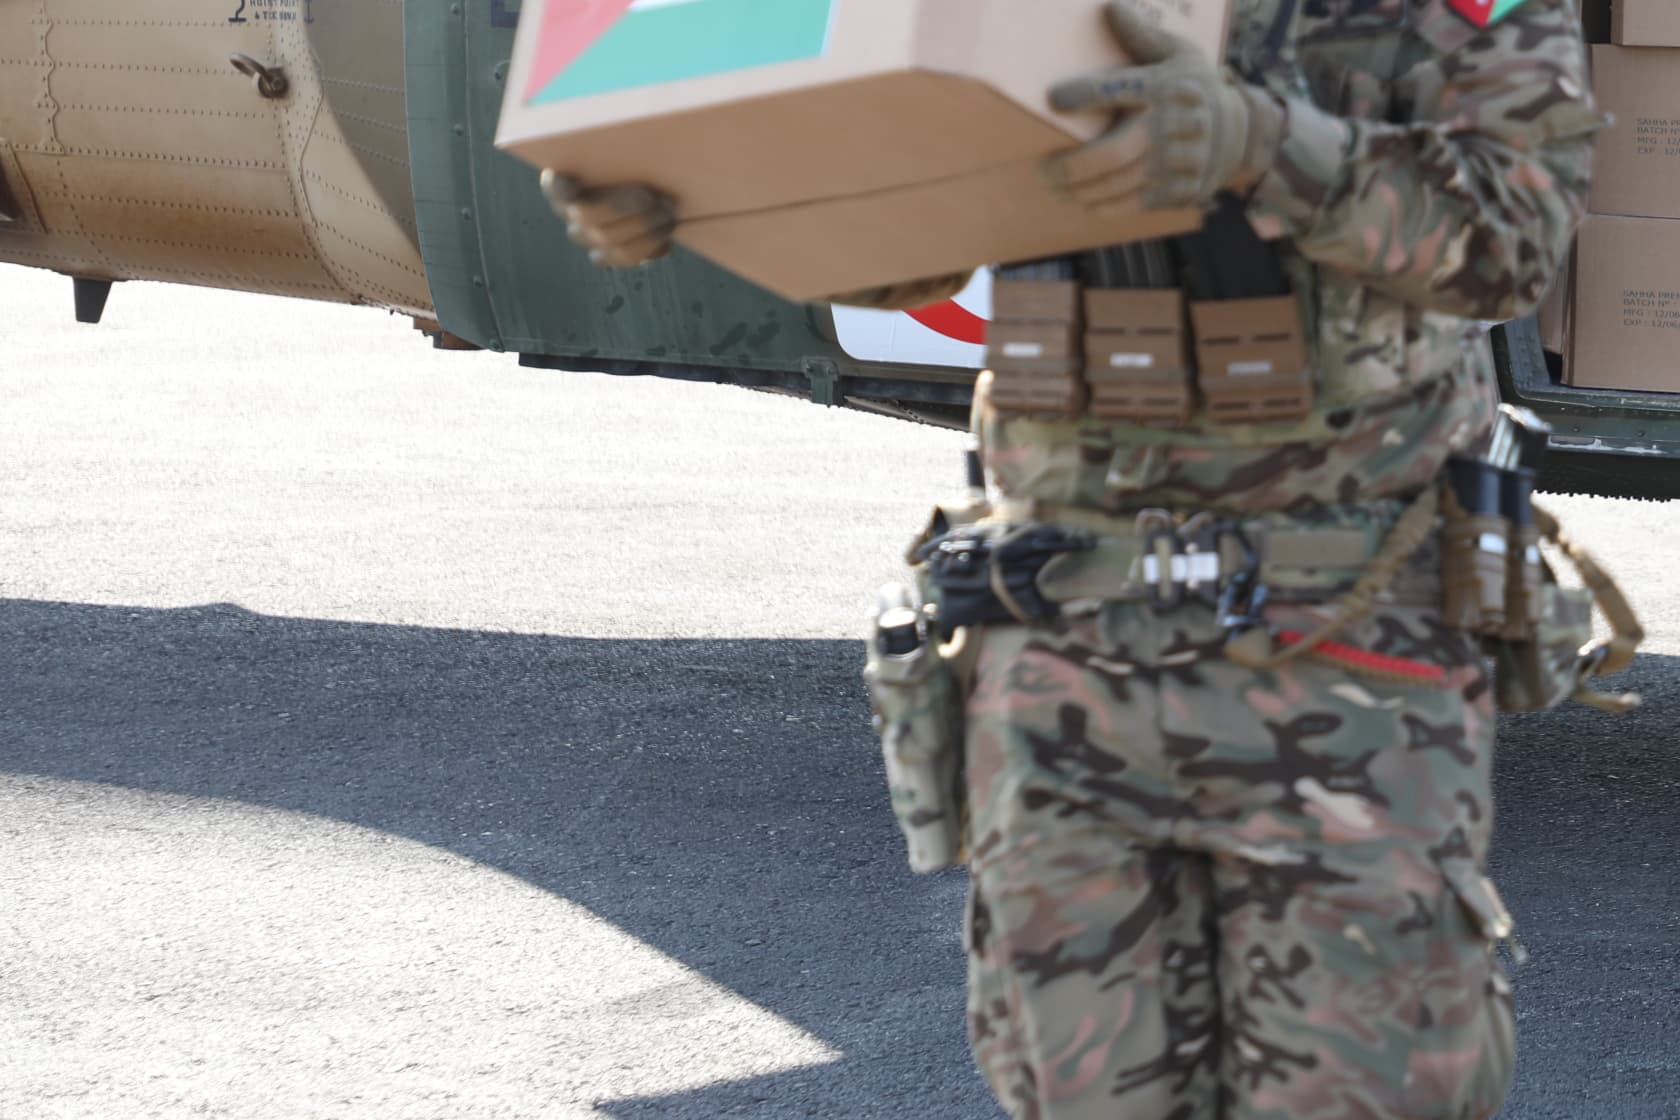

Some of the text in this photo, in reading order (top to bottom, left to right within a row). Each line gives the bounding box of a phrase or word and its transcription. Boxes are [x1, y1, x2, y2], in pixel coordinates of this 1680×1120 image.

[1637, 126, 1668, 135] BATCH
[1637, 136, 1657, 145] MFG
[1623, 298, 1656, 306] BATCH
[1623, 308, 1644, 317] MFG
[1623, 319, 1641, 327] EXP
